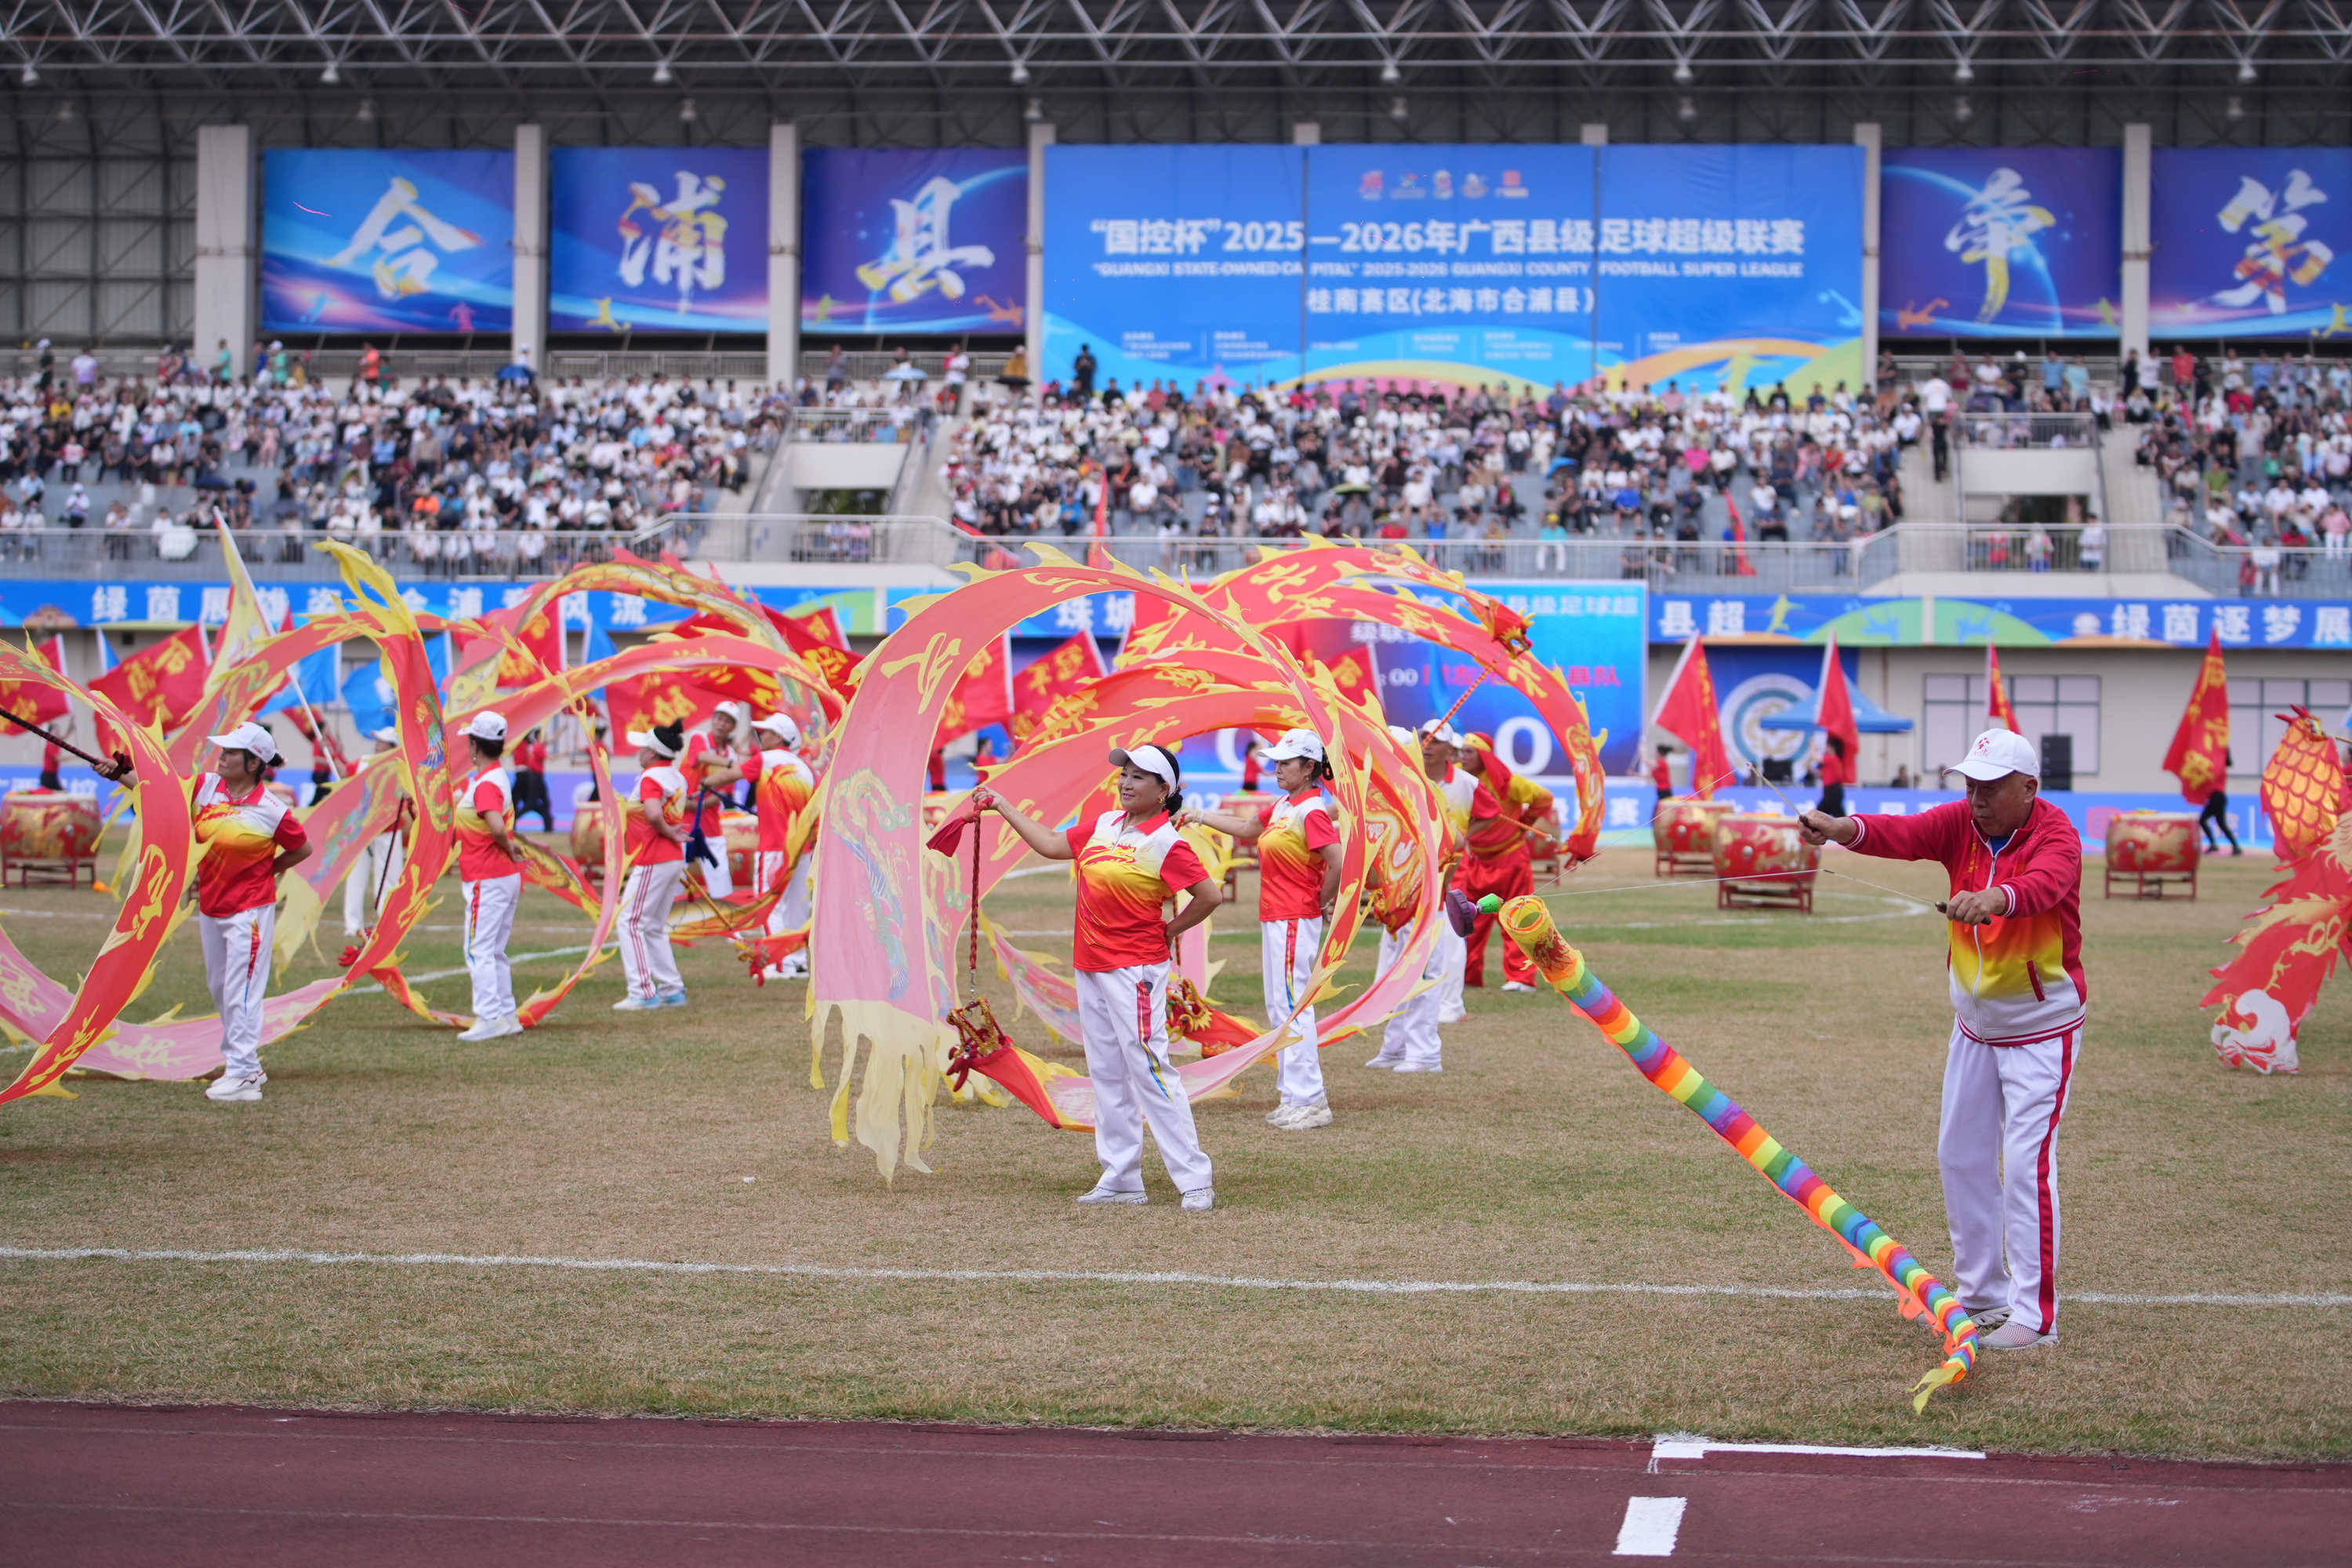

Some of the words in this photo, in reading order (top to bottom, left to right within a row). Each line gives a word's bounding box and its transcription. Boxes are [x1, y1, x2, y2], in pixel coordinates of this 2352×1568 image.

[323, 177, 484, 299] 合
[618, 169, 728, 314] 浦
[856, 176, 995, 303] 县
[1452, 262, 1523, 277] GUANGXI
[1526, 262, 1592, 277] COUNTY
[1599, 262, 1679, 277] FOOTBALL
[1682, 262, 1737, 277] SUPER
[1740, 262, 1803, 278] LEAGUE
[1659, 599, 1745, 637] 县超
[1494, 716, 1553, 775] 0
